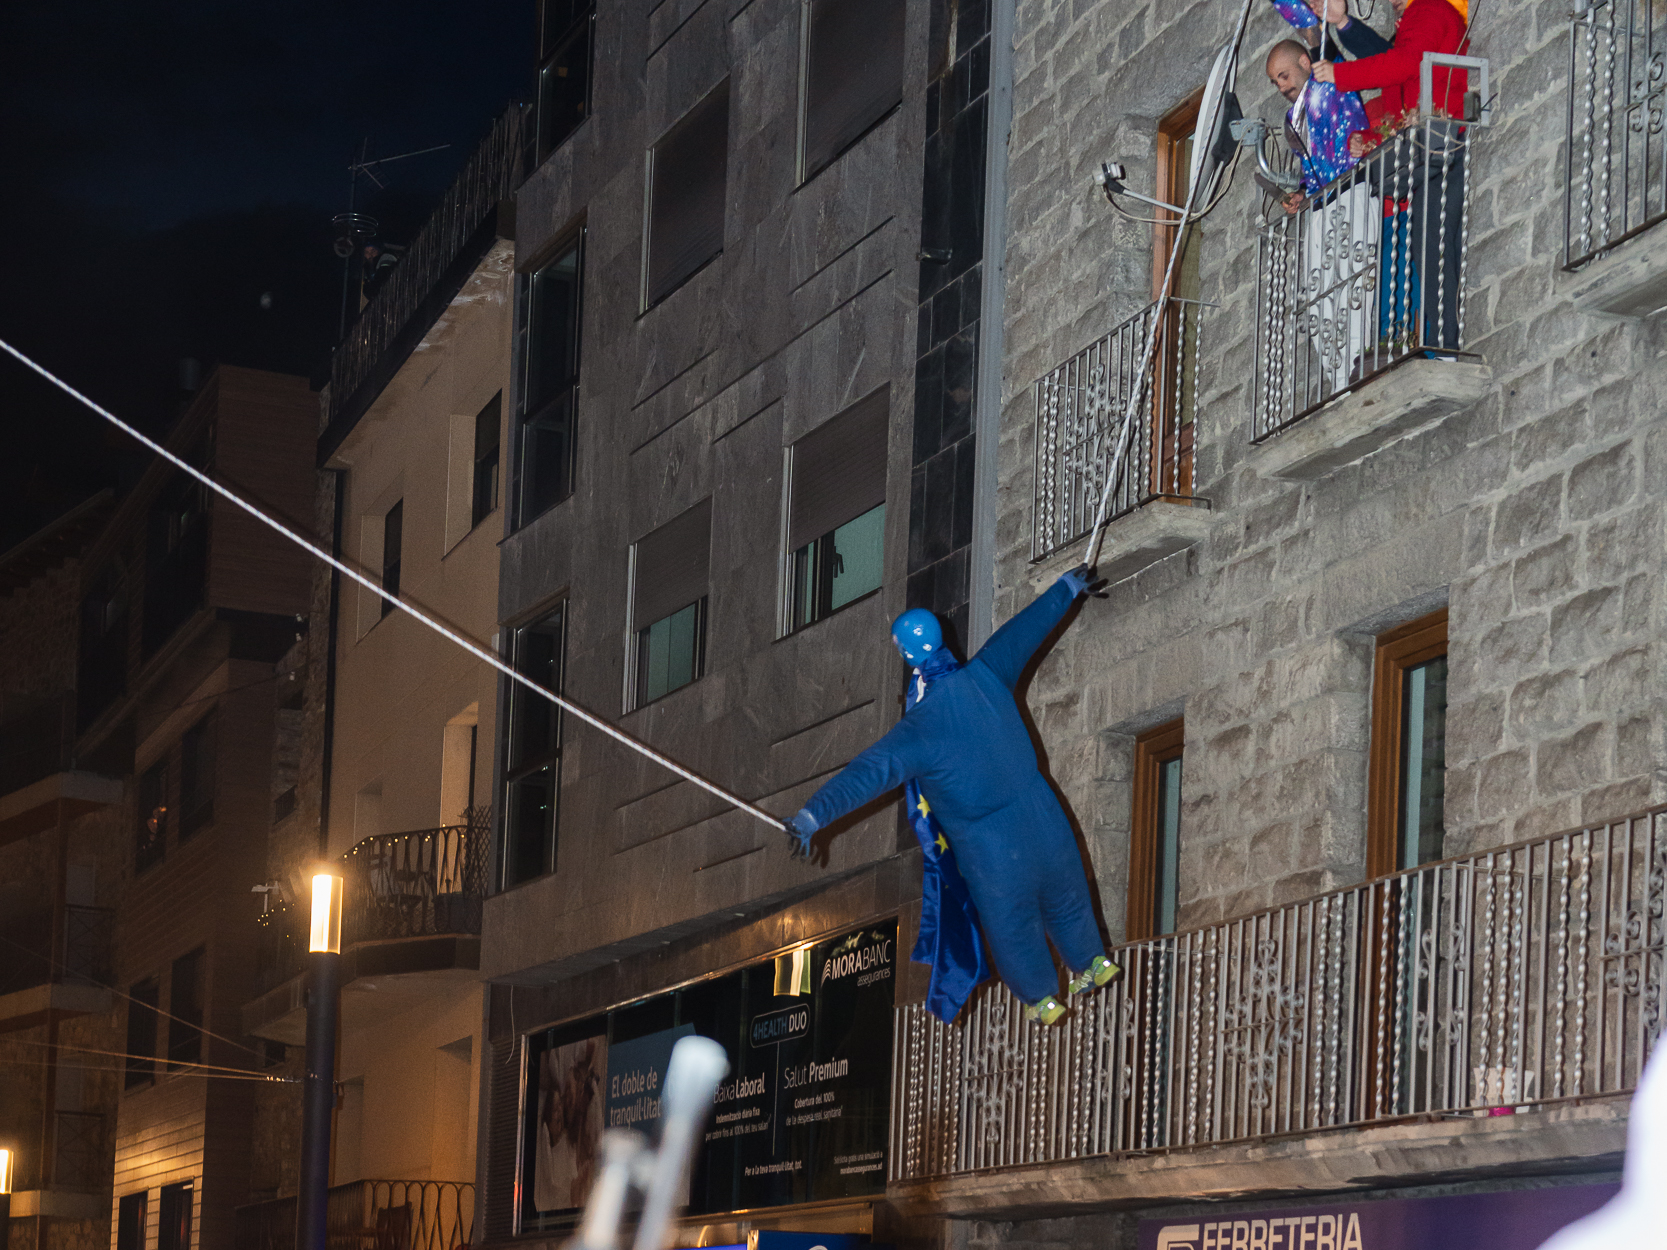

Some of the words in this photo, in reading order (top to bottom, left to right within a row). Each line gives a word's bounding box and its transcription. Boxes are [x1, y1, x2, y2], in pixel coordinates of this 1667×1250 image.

[831, 940, 891, 980] MORABANC
[857, 967, 891, 987] assegurances
[752, 1016, 788, 1041] 4HEALTH
[788, 1011, 807, 1032] DUO
[611, 1075, 620, 1098] El
[621, 1070, 645, 1096] doble
[646, 1066, 658, 1091] de
[713, 1083, 735, 1104] Baixa
[735, 1072, 765, 1099] Laboral
[784, 1065, 807, 1089] Salut
[809, 1056, 848, 1083] Premium
[794, 1097, 814, 1109] Cobertura
[823, 1091, 835, 1103] 100%
